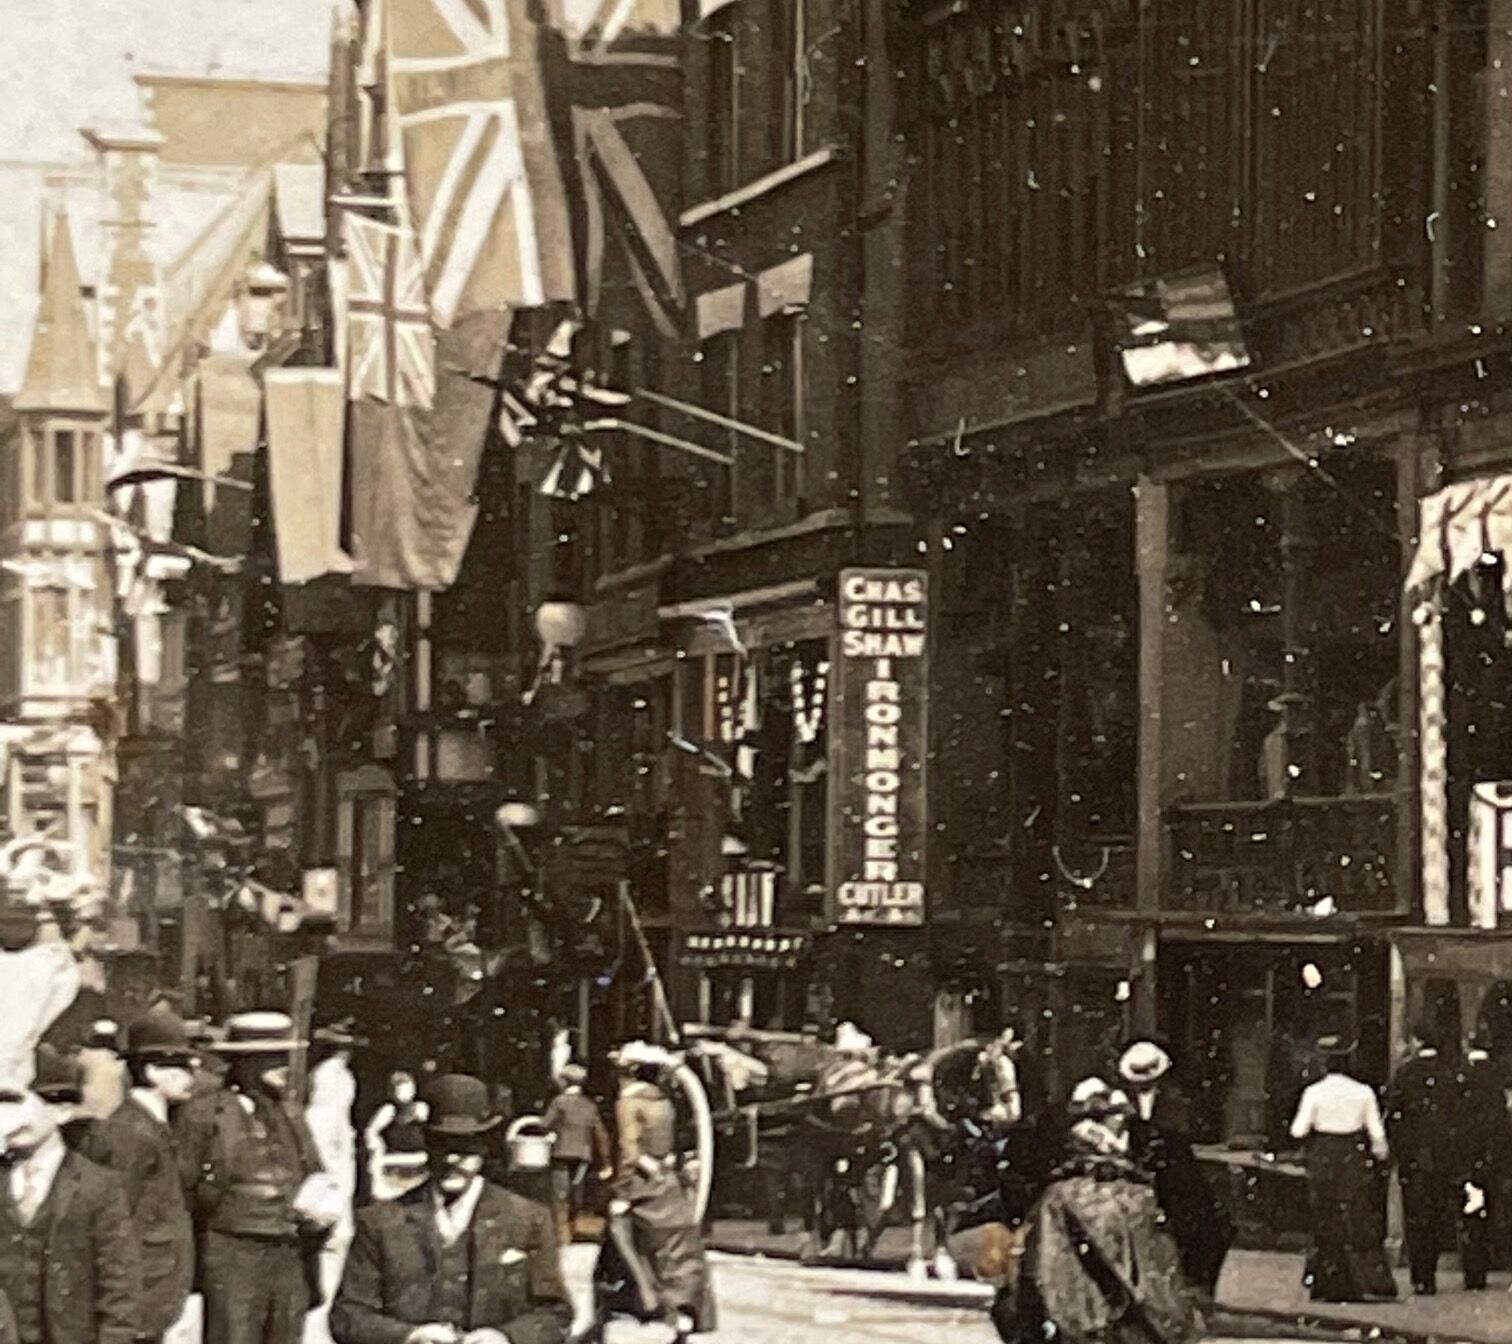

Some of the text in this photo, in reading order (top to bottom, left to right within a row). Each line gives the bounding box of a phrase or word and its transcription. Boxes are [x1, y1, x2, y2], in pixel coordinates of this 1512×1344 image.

[845, 577, 922, 602] CHAS
[847, 604, 925, 628] GILL
[843, 630, 926, 657] SHAW
[864, 658, 901, 881] IRONMONGER
[838, 882, 924, 907] CUTLER
